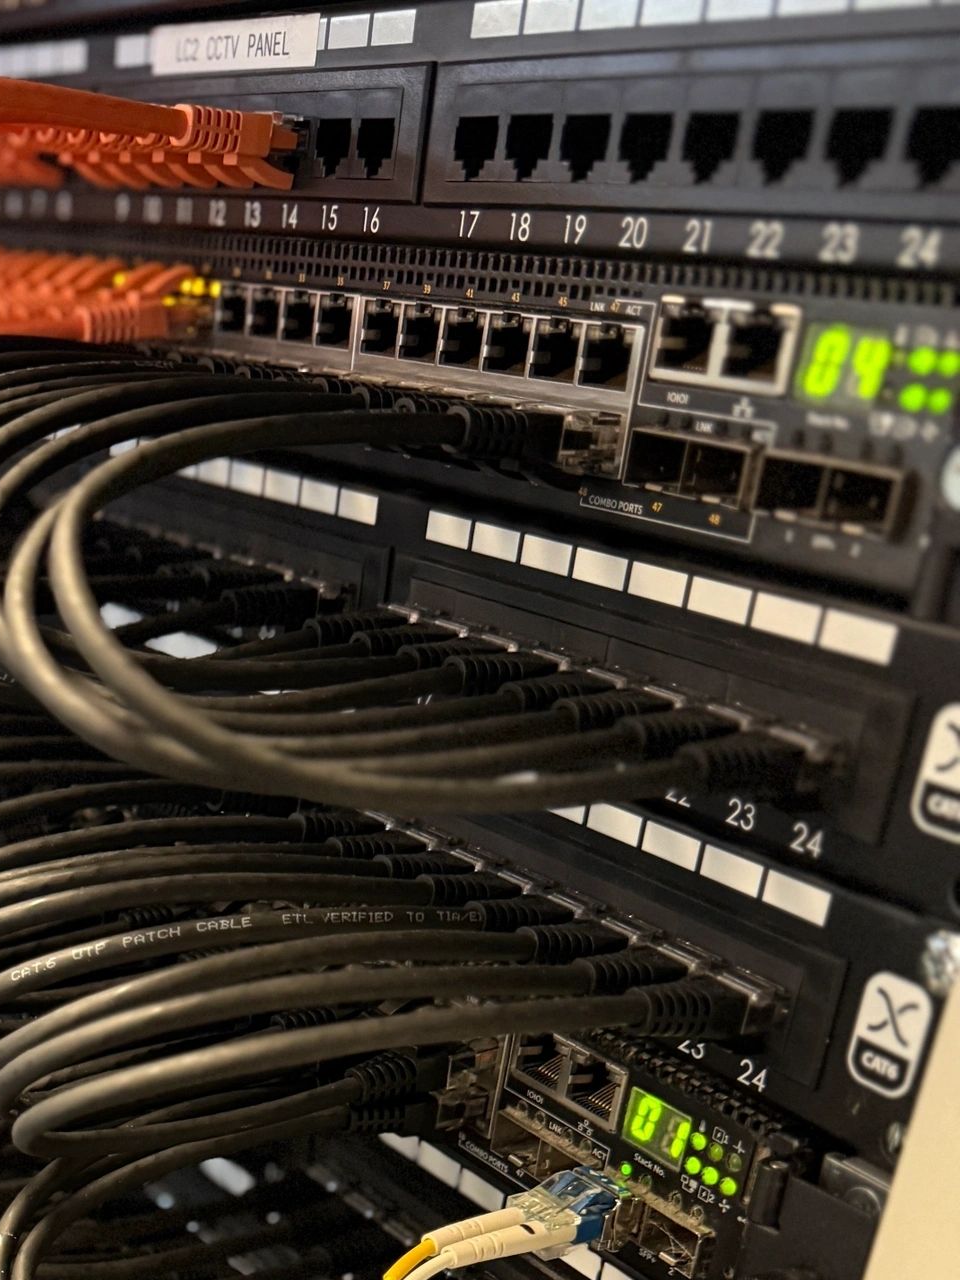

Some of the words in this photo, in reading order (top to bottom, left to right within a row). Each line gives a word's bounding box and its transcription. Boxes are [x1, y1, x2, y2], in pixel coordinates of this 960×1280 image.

[176, 38, 200, 62] LC2
[206, 35, 239, 61] CCTV
[247, 31, 290, 58] PANEL
[208, 199, 227, 227] 12
[244, 201, 261, 228] 13
[282, 203, 298, 229] 14
[321, 205, 340, 230] 15
[363, 206, 380, 233] 16
[459, 210, 480, 239] 17
[510, 212, 531, 242] 18
[564, 214, 587, 245] 19
[619, 216, 648, 249] 20
[683, 218, 713, 253] 21
[746, 220, 785, 259] 22
[818, 222, 860, 264] 23
[896, 225, 941, 268] 24
[382, 280, 391, 291] 37
[423, 283, 432, 295] 39
[465, 288, 475, 299] 41
[512, 292, 521, 303] 43
[558, 296, 568, 307] 45
[610, 302, 621, 313] 47
[625, 304, 643, 317] ACT
[804, 323, 891, 400] 04
[589, 494, 617, 509] COMBO
[618, 502, 643, 515] PORTS
[651, 502, 663, 513] 47
[708, 513, 721, 526] 48
[725, 798, 756, 831] 23
[789, 821, 823, 859] 24
[10, 957, 58, 982] CAT.6
[71, 939, 108, 961] UTP
[121, 926, 182, 949] PATCH
[196, 916, 253, 933] CABLE
[282, 913, 314, 926] ETL
[322, 910, 394, 924] VERIFIED
[406, 911, 425, 923] TO
[736, 1058, 767, 1093] 24
[861, 1050, 899, 1081] CAT6
[548, 1121, 564, 1135] LNK
[631, 1096, 692, 1159] 01
[465, 1141, 489, 1162] COMBO
[488, 1155, 509, 1175] PORTS
[591, 1148, 607, 1161] ACT
[633, 1152, 654, 1170] Stack
[652, 1164, 666, 1178] No.
